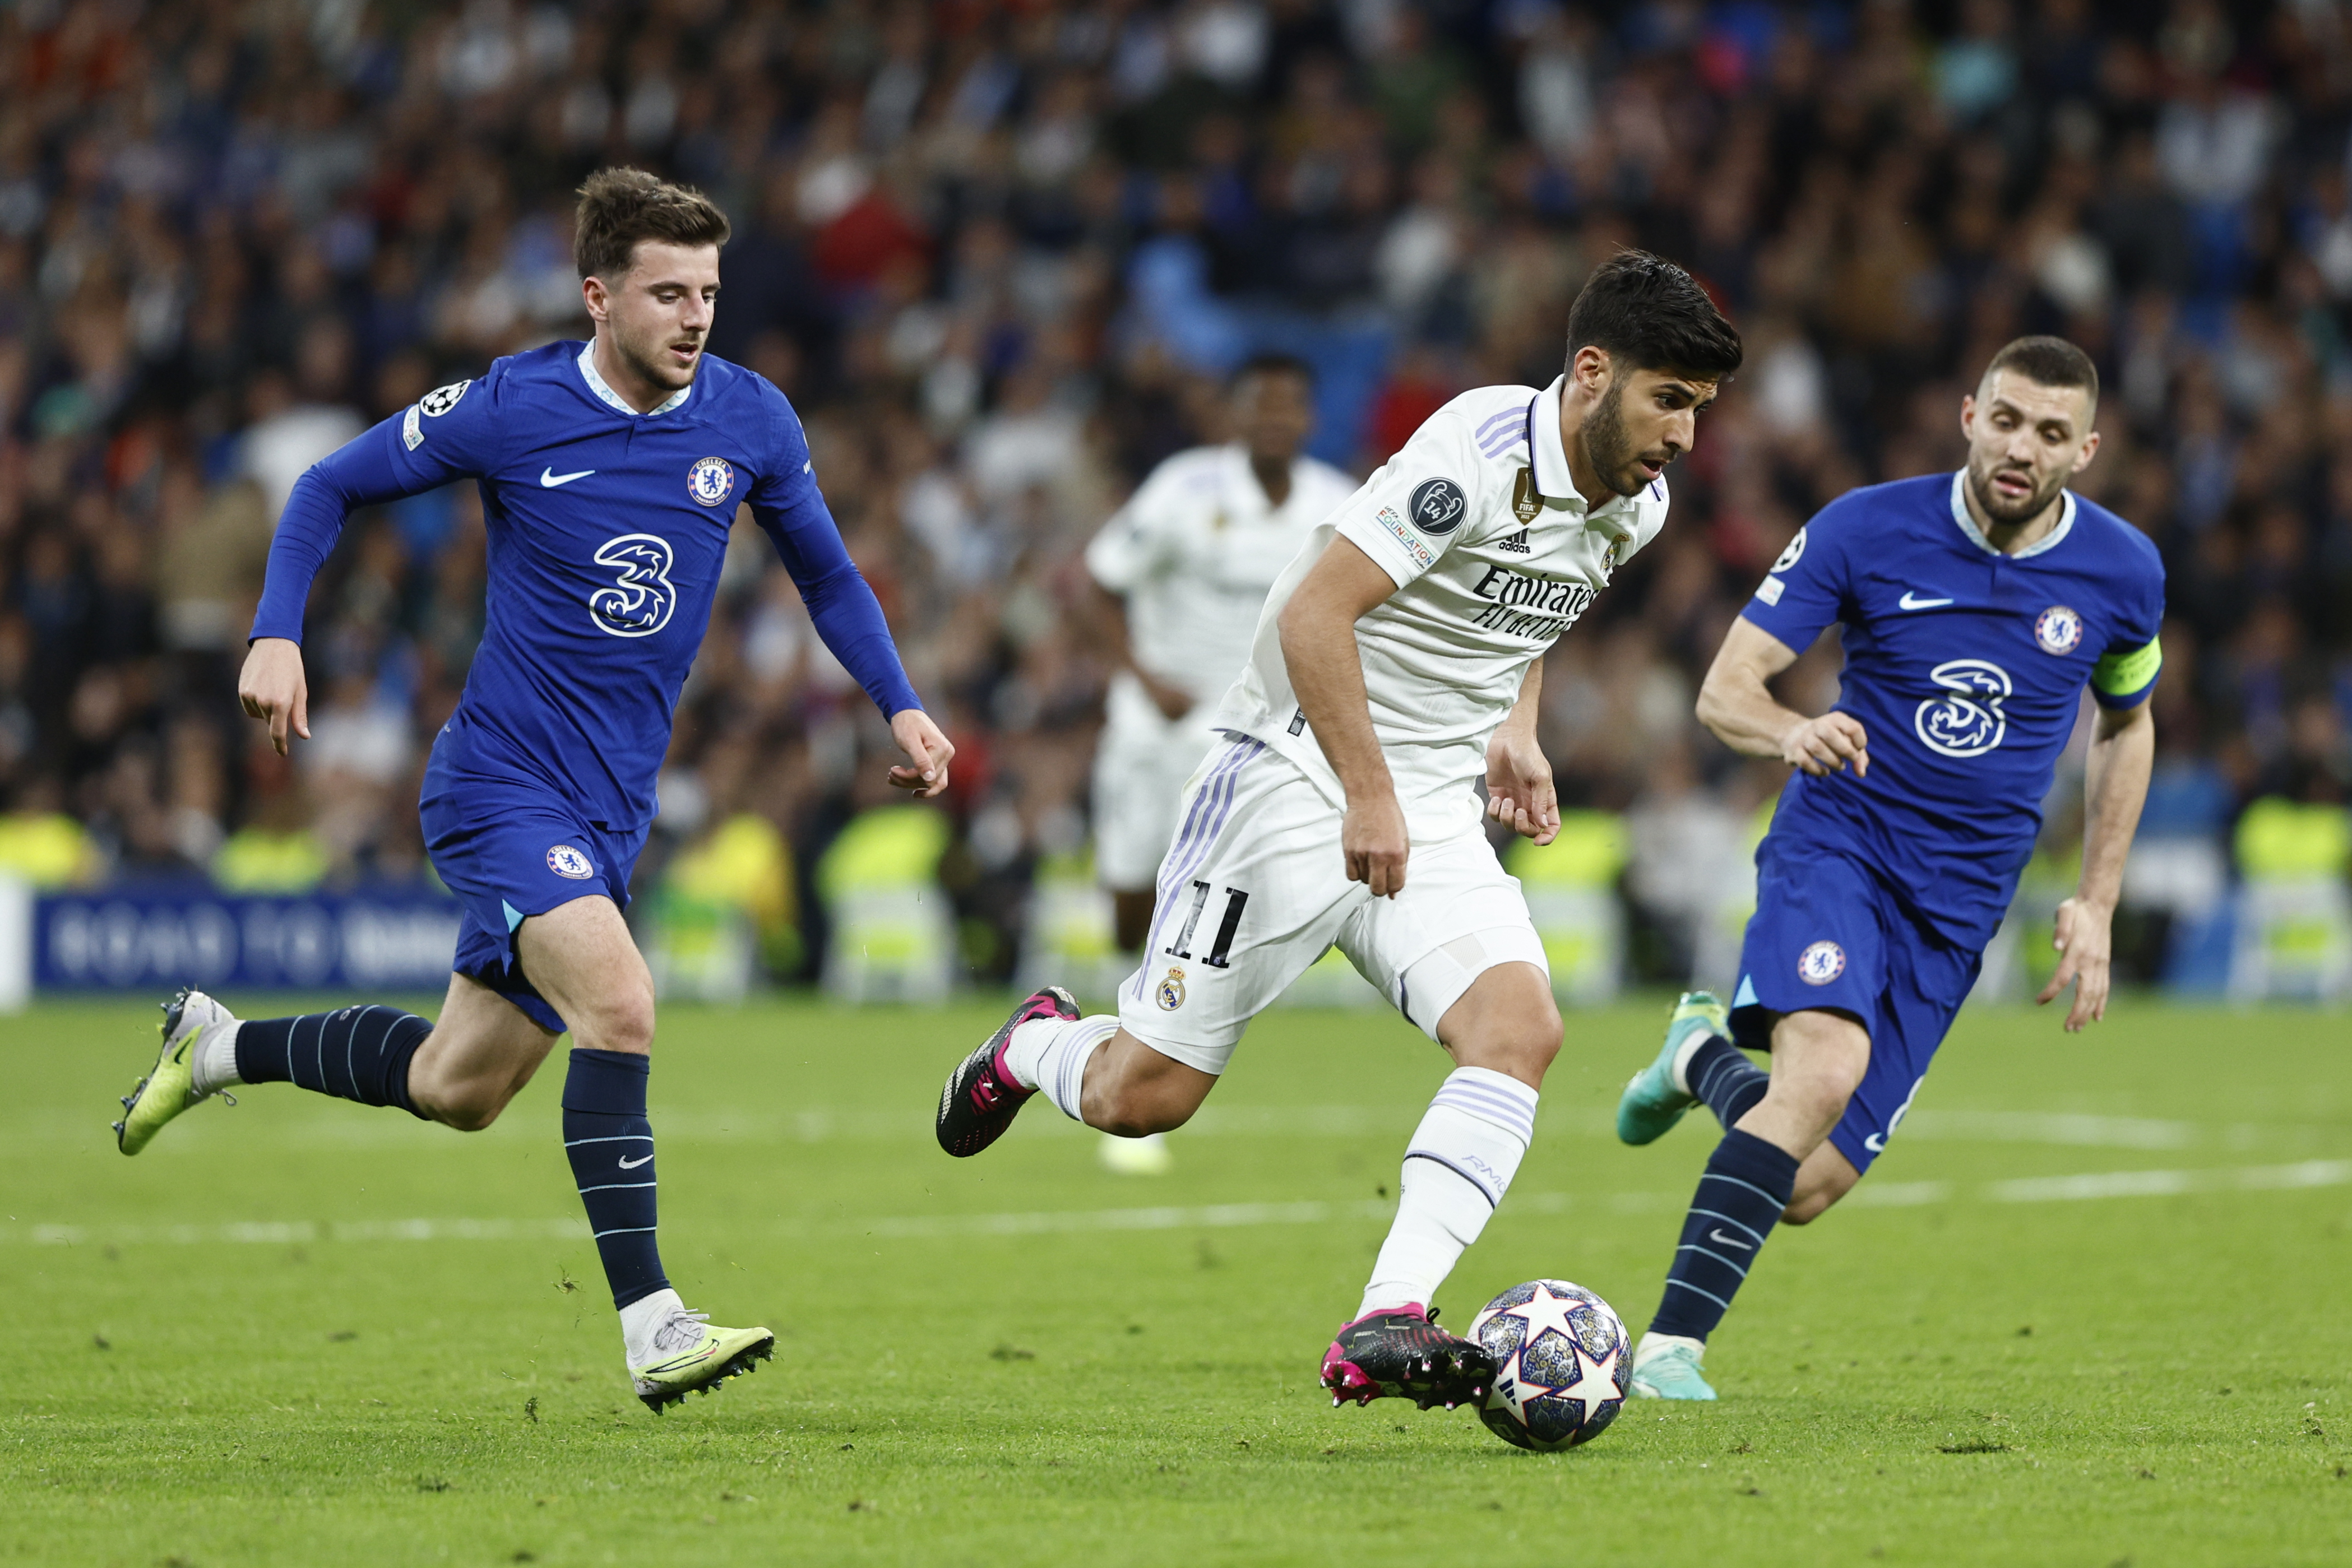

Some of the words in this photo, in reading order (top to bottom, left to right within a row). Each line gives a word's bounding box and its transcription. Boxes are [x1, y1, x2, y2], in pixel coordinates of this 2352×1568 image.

[696, 459, 727, 470] CHELSEA
[696, 494, 715, 504] FOOTBALL
[1385, 505, 1399, 519] UEFA
[1424, 501, 1441, 519] 14
[1378, 509, 1434, 565] FOUNDATION
[1499, 541, 1531, 554] adidas
[1471, 603, 1518, 630] FLY
[1165, 880, 1249, 968] 11
[1461, 1154, 1506, 1196] RMC
